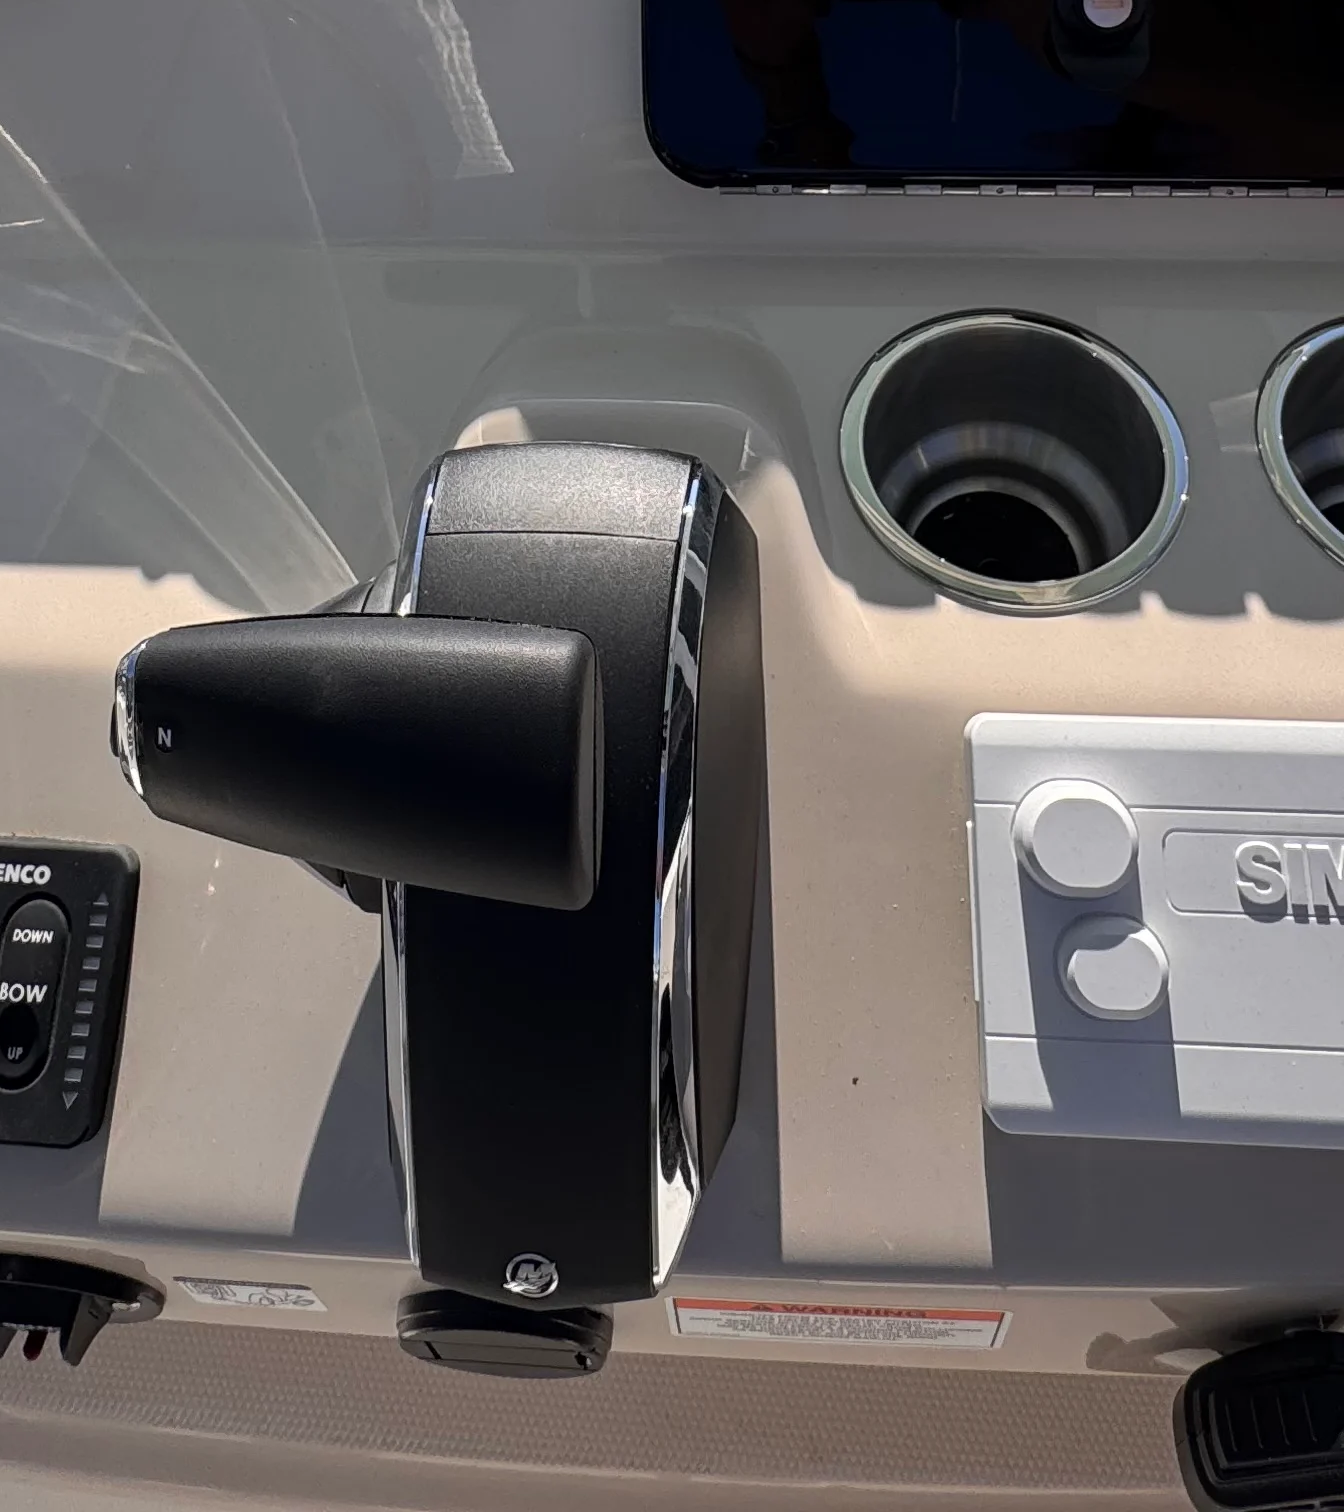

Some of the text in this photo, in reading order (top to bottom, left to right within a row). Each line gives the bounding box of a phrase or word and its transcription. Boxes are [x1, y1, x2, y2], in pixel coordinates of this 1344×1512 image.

[158, 727, 172, 748] N
[12, 929, 54, 944] DOWN
[7, 1047, 23, 1060] UP
[781, 1303, 928, 1319] WARNING
